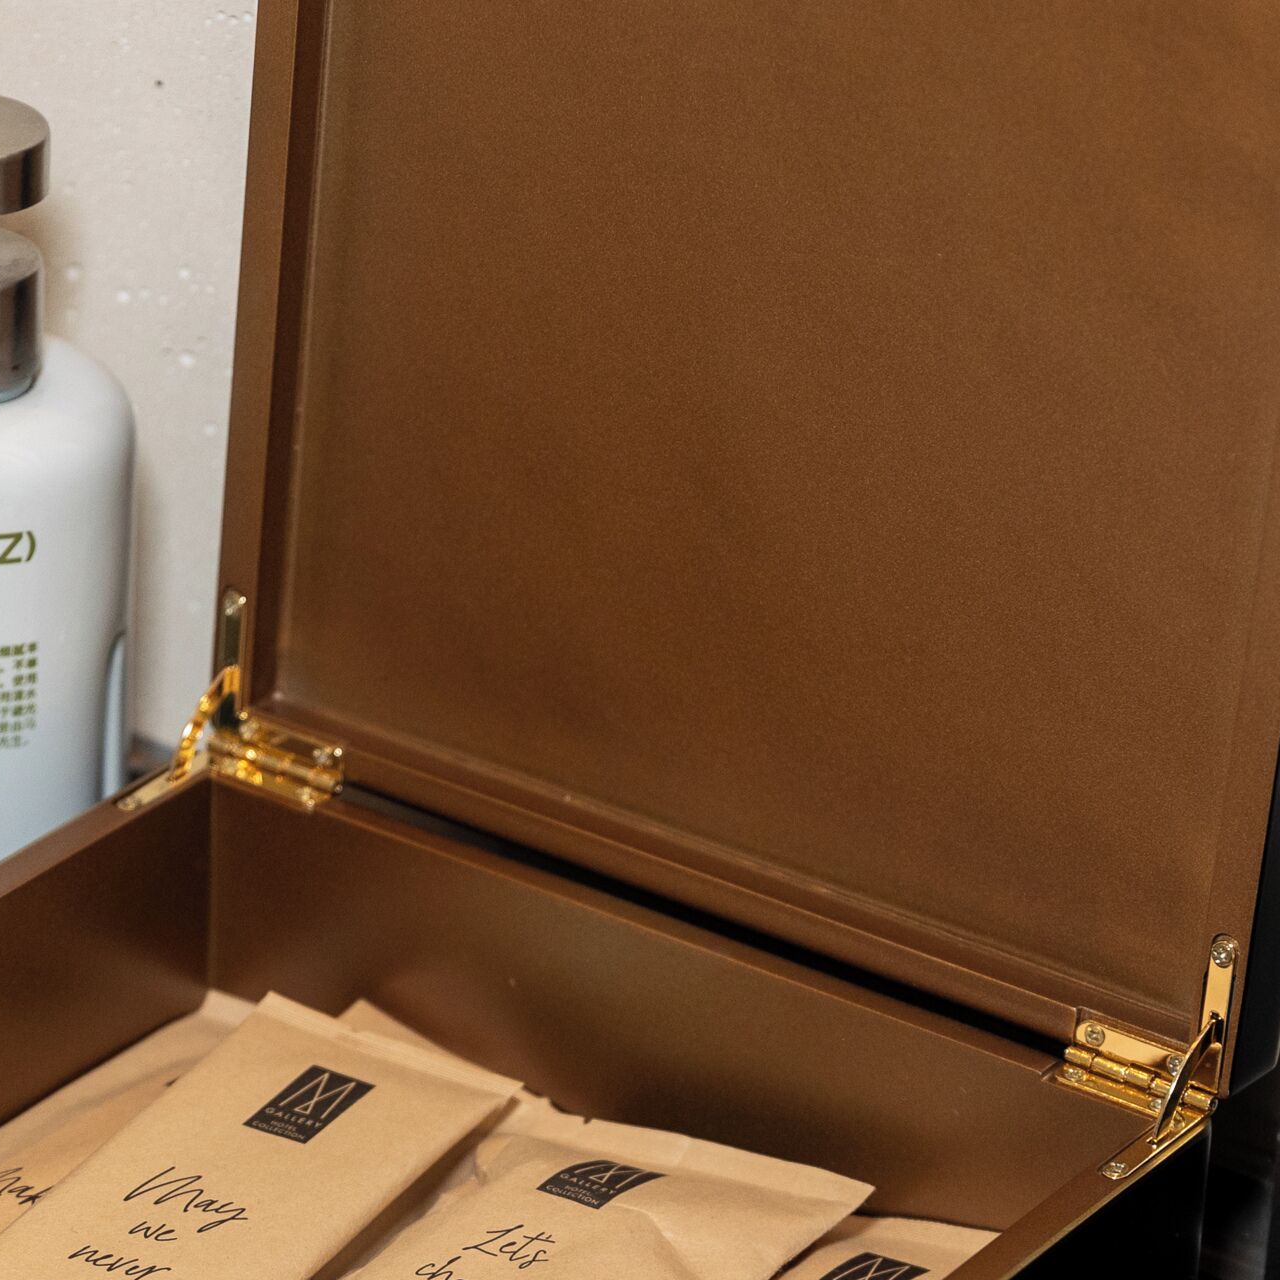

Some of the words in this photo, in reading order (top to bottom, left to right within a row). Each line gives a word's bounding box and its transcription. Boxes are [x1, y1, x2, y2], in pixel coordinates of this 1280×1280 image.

[264, 1106, 322, 1129] GALLERY
[252, 1120, 306, 1140] COLLECTION
[560, 1172, 617, 1194] GALLERY
[123, 1166, 249, 1234] May
[546, 1185, 600, 1205] COLLECTION
[128, 1220, 178, 1242] we
[462, 1224, 556, 1269] Let's
